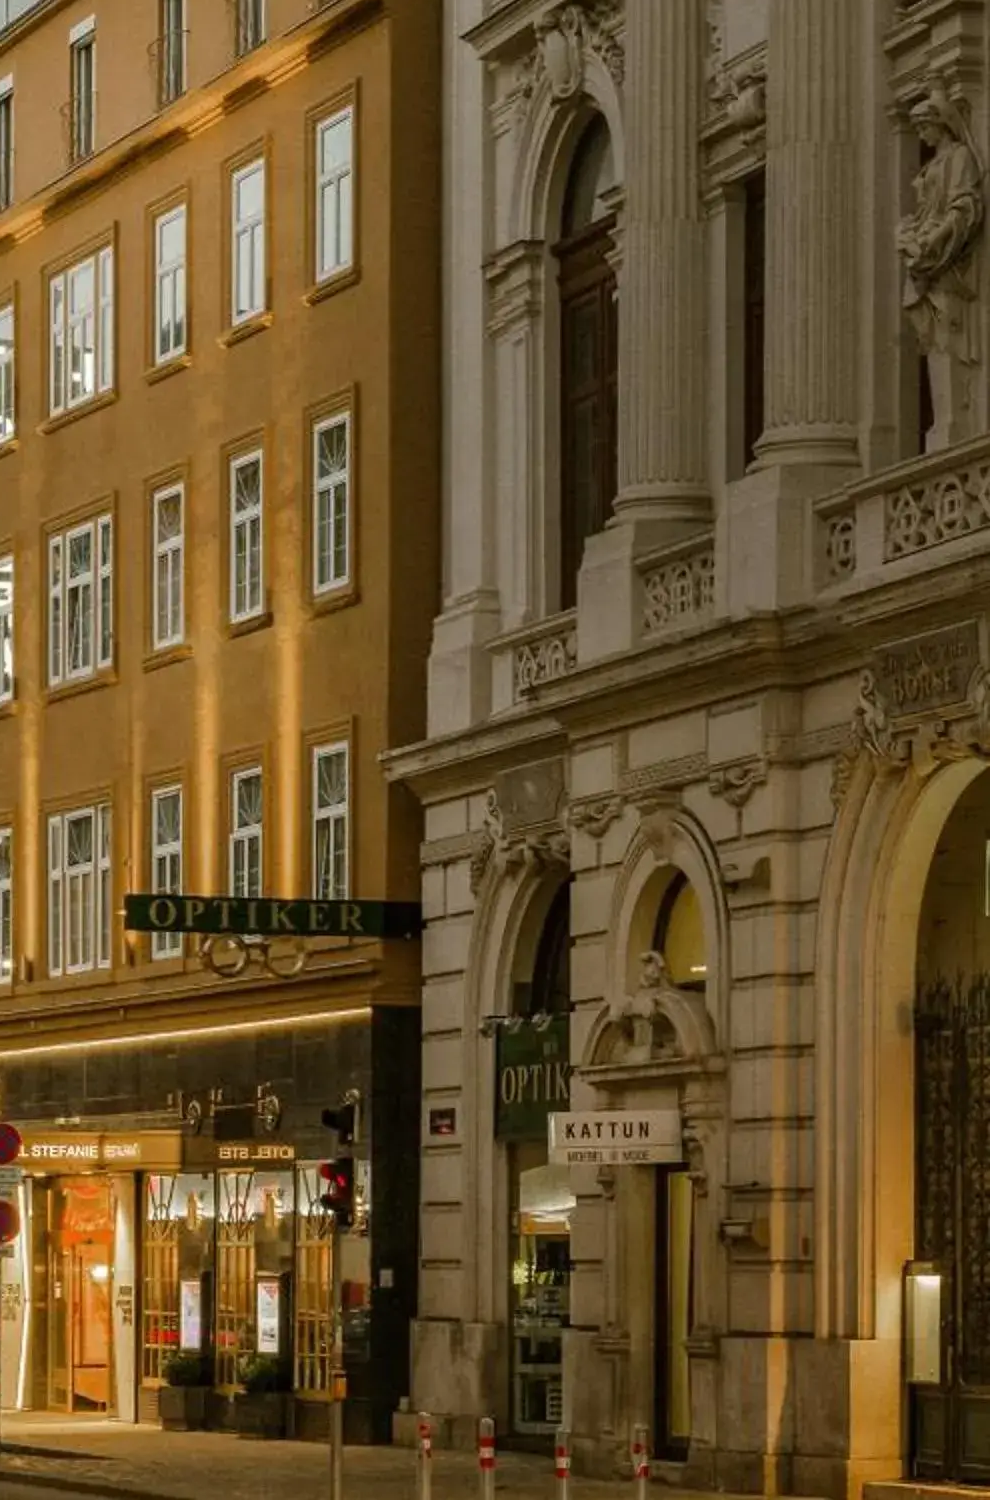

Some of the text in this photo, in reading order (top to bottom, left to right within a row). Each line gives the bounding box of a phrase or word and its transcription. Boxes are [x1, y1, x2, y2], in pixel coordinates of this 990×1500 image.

[149, 898, 364, 932] OPTIKER
[565, 1121, 650, 1139] KATTUN
[31, 1144, 99, 1159] STEFANIE
